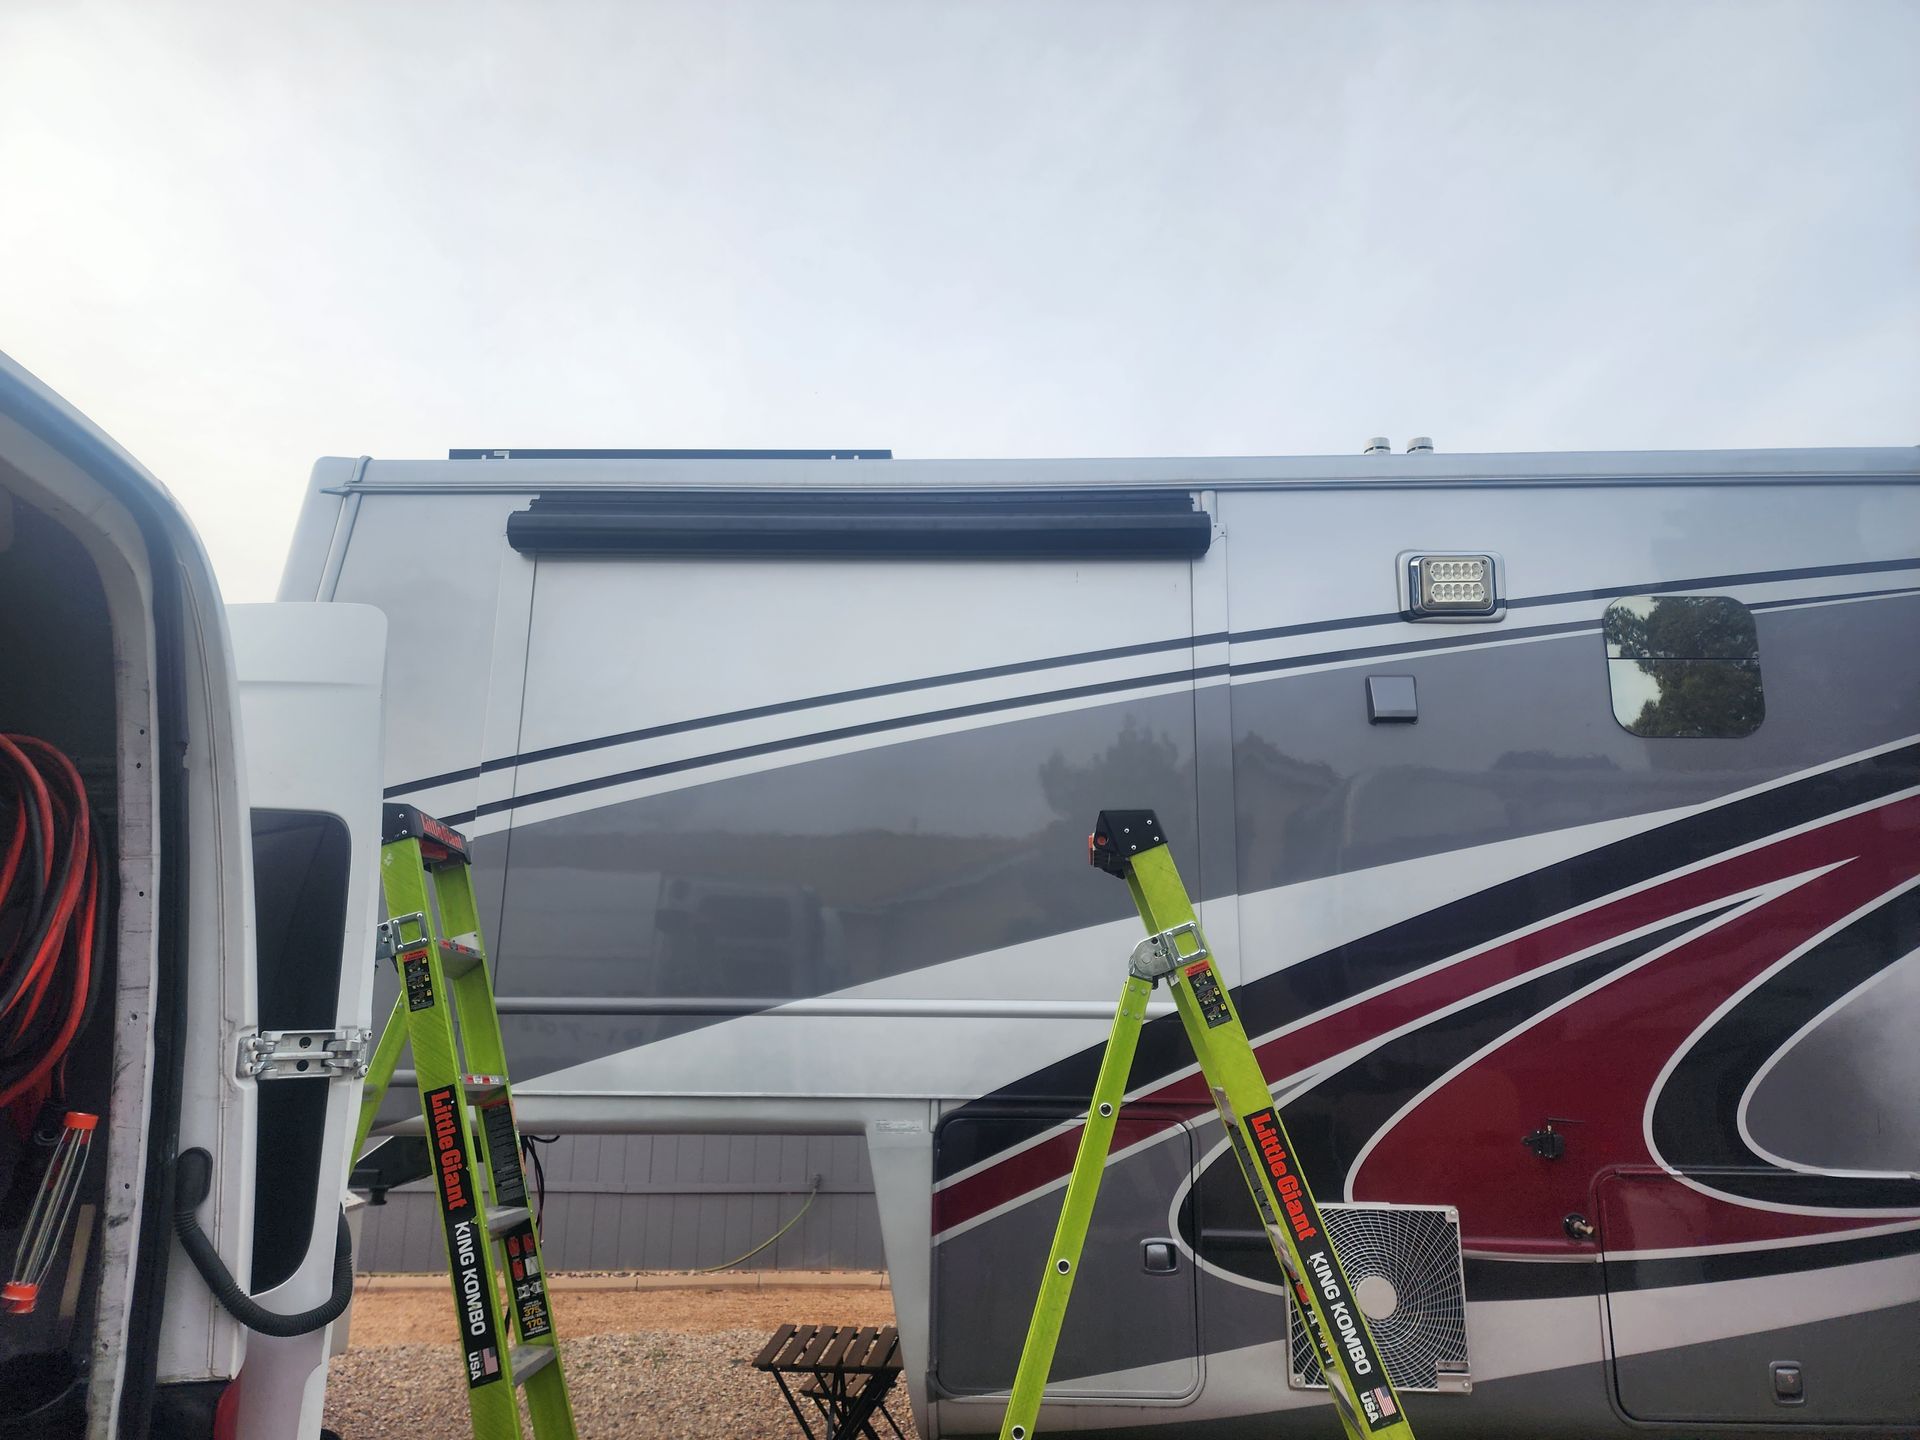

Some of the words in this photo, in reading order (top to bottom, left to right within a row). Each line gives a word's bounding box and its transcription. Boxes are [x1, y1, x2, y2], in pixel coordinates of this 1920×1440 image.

[431, 1090, 457, 1150] Little
[440, 1148, 468, 1211] Giant
[1251, 1112, 1287, 1177] Little
[1277, 1174, 1317, 1241] Giant
[455, 1221, 475, 1266] KING
[462, 1267, 486, 1336] KOMBO
[526, 1317, 543, 1328] 170
[1310, 1251, 1341, 1300] KING
[1330, 1301, 1372, 1375] KOMBO
[468, 1351, 481, 1380] USA
[1360, 1391, 1379, 1424] USA
